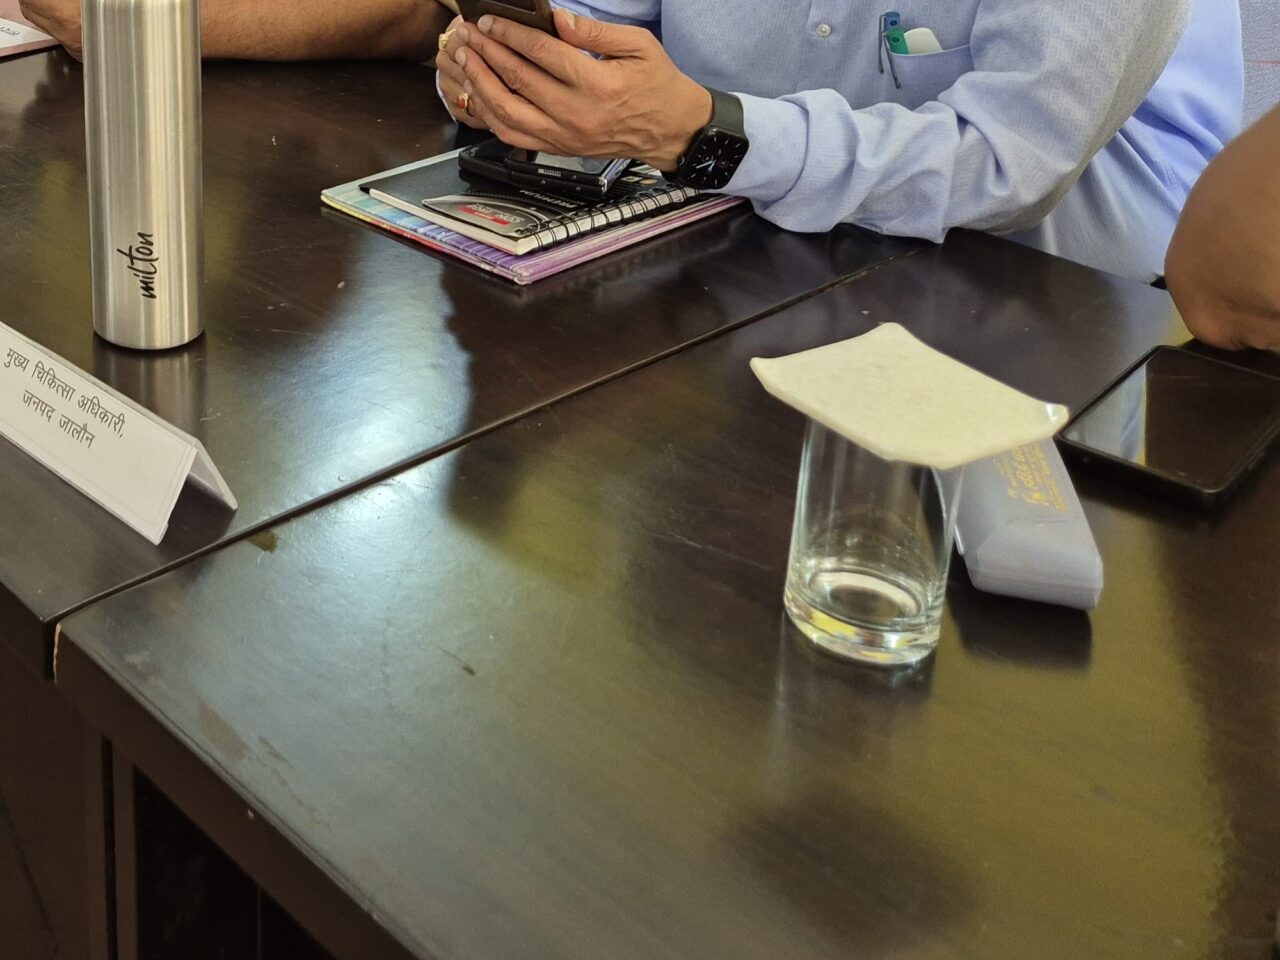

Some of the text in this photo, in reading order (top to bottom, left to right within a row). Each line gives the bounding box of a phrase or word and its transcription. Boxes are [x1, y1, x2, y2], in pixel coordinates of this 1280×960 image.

[520, 189, 578, 208] PREMIUM
[116, 232, 159, 299] milton
[3, 347, 125, 438] मुख्य चिकित्सा अधिकारी,
[22, 389, 95, 449] जनपद जालौन
